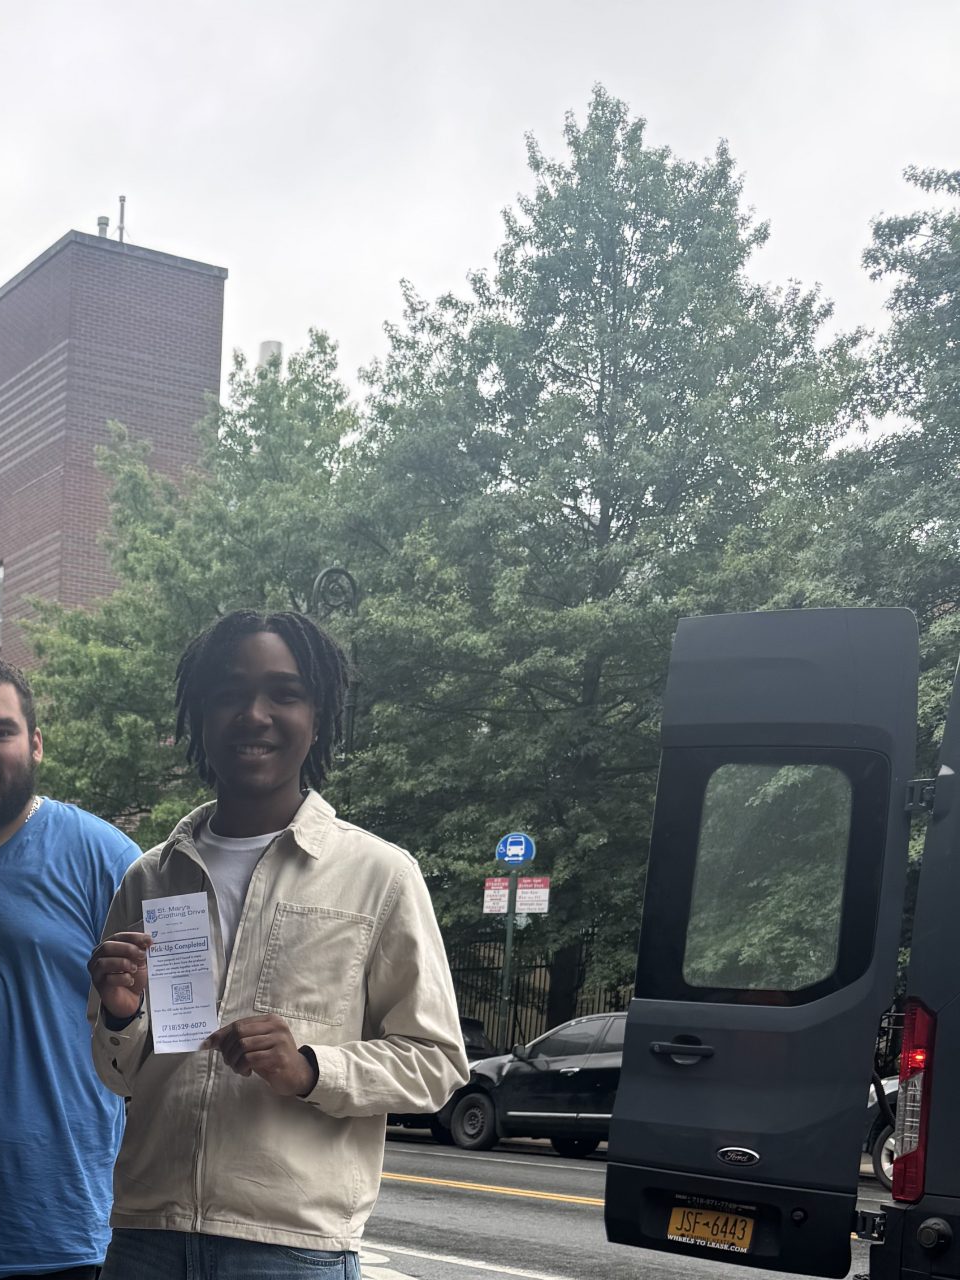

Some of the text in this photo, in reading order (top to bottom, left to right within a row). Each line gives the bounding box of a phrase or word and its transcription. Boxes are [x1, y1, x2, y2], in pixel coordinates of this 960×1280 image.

[157, 911, 187, 920] Clothing
[150, 939, 206, 953] Pick-Up Completed
[724, 1151, 749, 1162] Ford
[667, 1234, 695, 1245] WHEELS
[707, 1242, 748, 1254] LEASE.COM
